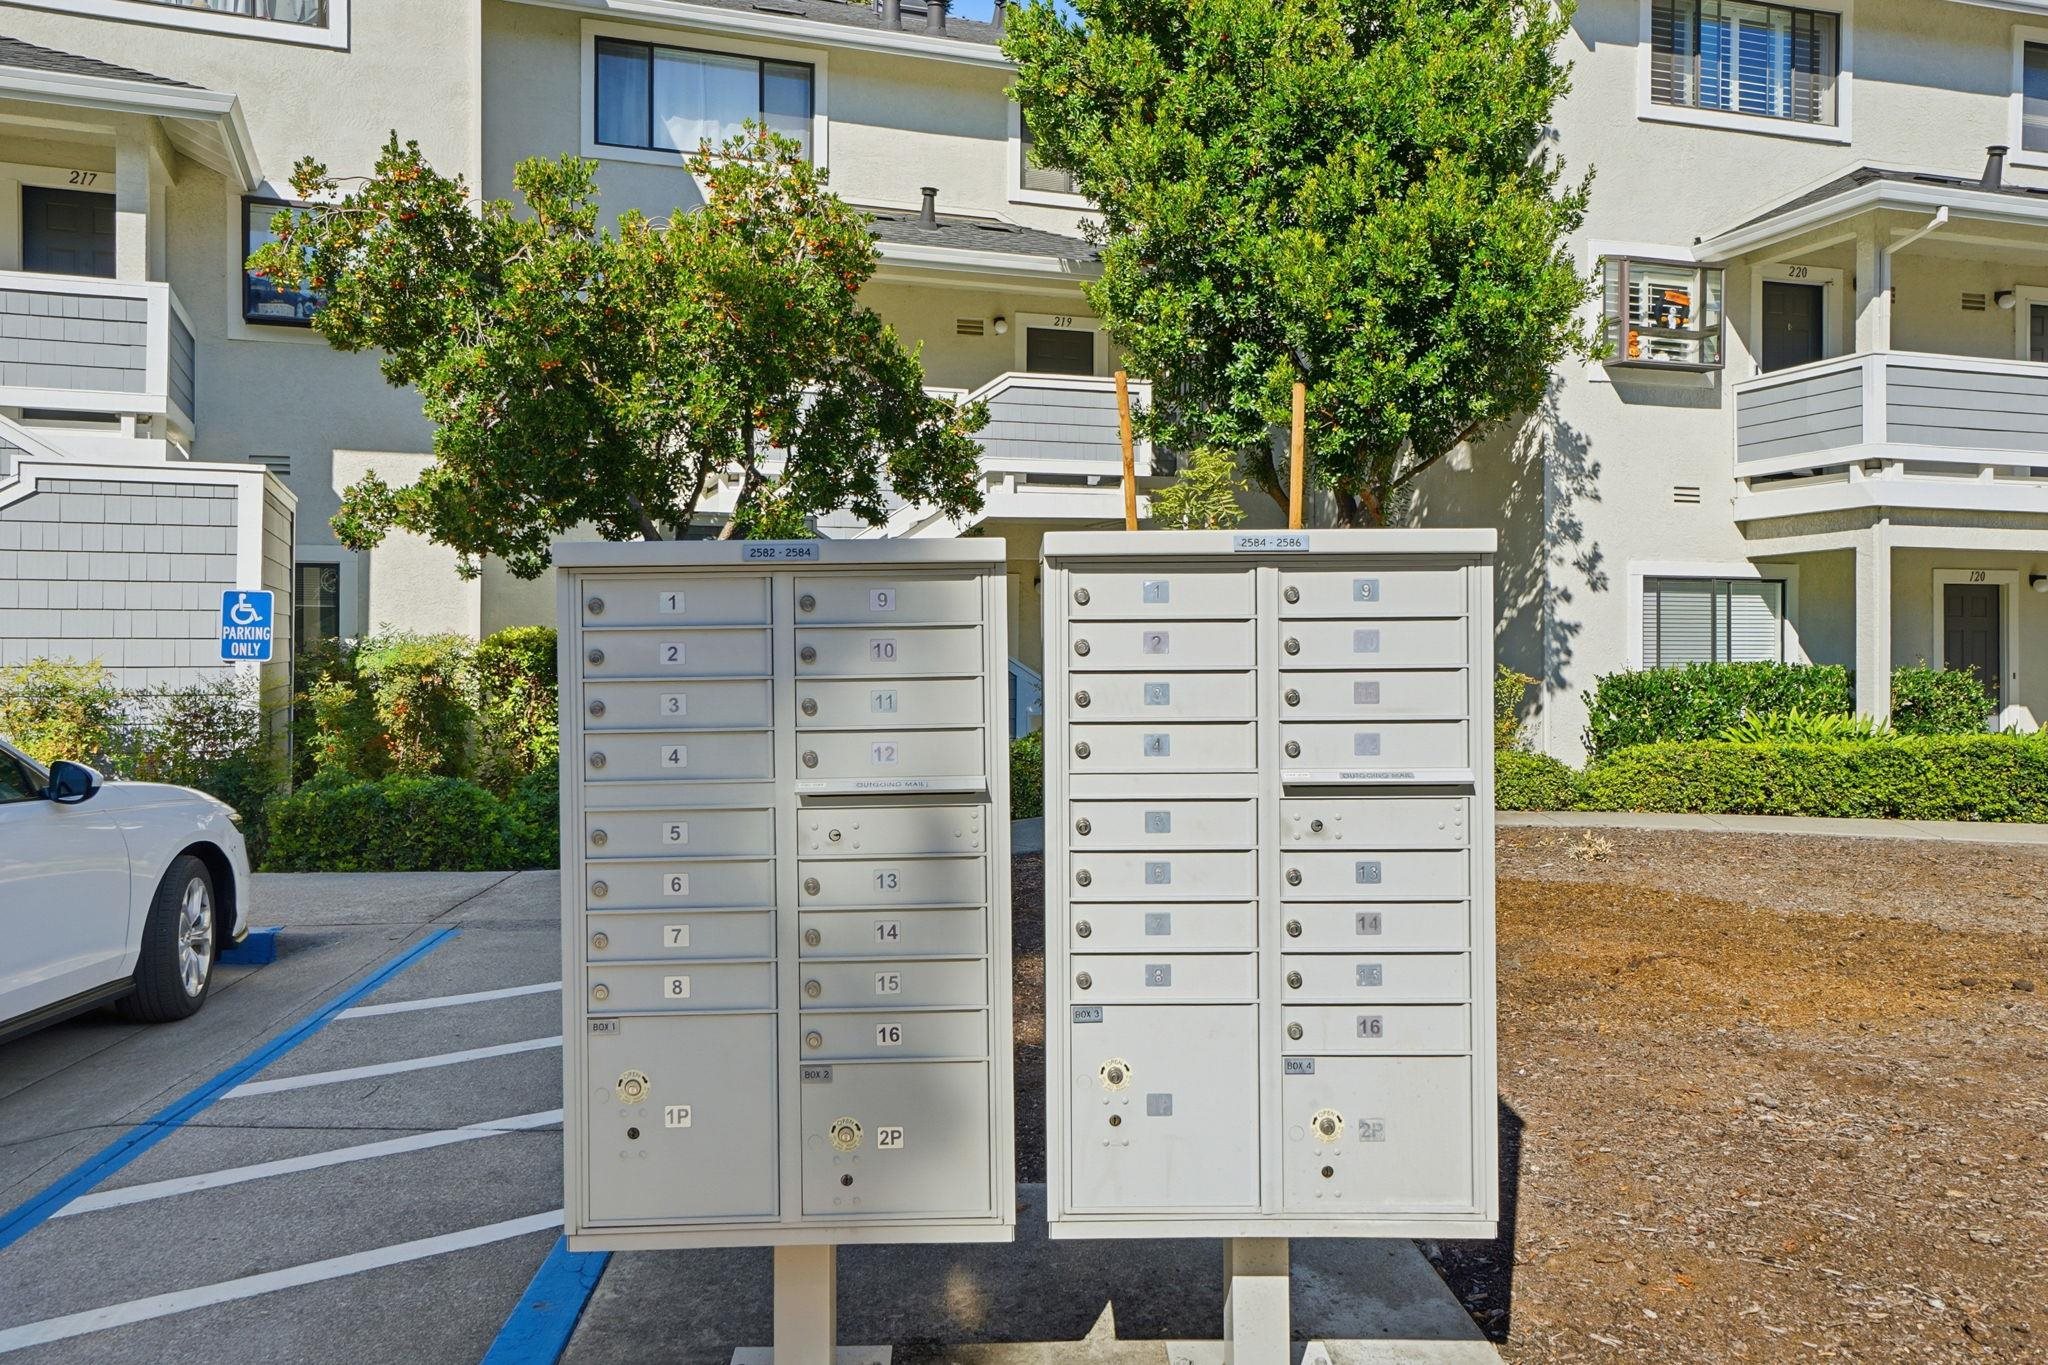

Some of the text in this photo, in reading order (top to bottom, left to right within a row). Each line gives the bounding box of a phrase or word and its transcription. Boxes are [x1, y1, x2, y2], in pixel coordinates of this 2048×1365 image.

[69, 170, 97, 187] 217
[1788, 265, 1808, 278] 220
[1053, 315, 1073, 328] 219
[1240, 537, 1266, 548] 2584
[1276, 537, 1302, 548] 2586
[749, 547, 775, 558] 2582
[785, 547, 811, 558] 2584
[1969, 570, 1986, 583] 120
[1152, 584, 1160, 600] 1
[1360, 583, 1372, 600] 9
[668, 595, 677, 610] 1
[877, 592, 888, 607] 9
[222, 625, 271, 642] PARKING
[230, 642, 261, 657] ONLY
[667, 646, 678, 661] 2
[873, 643, 894, 658] 10
[668, 698, 679, 713] 3
[875, 694, 894, 709] 11
[1152, 737, 1161, 752] 4
[668, 749, 680, 764] 4
[874, 747, 895, 762] 12
[1342, 771, 1389, 780] OUTGOING
[856, 780, 902, 789] OUTGOING
[669, 826, 681, 841] 5
[1358, 866, 1379, 881] 13
[671, 877, 682, 892] 6
[876, 874, 898, 889] 13
[1358, 917, 1380, 932] 14
[671, 928, 682, 944] 7
[876, 925, 898, 940] 14
[877, 976, 899, 991] 15
[1152, 968, 1164, 984] 8
[672, 980, 683, 995] 8
[1074, 1010, 1100, 1019] BOX 3
[592, 1023, 609, 1032] BOX
[878, 1027, 900, 1043] 16
[1359, 1020, 1380, 1035] 16
[1286, 1061, 1313, 1071] BOX 4
[804, 1070, 830, 1080] BOX 2
[666, 1109, 689, 1124] 1P
[1360, 1121, 1383, 1138] 2P
[879, 1130, 902, 1146] 2P
